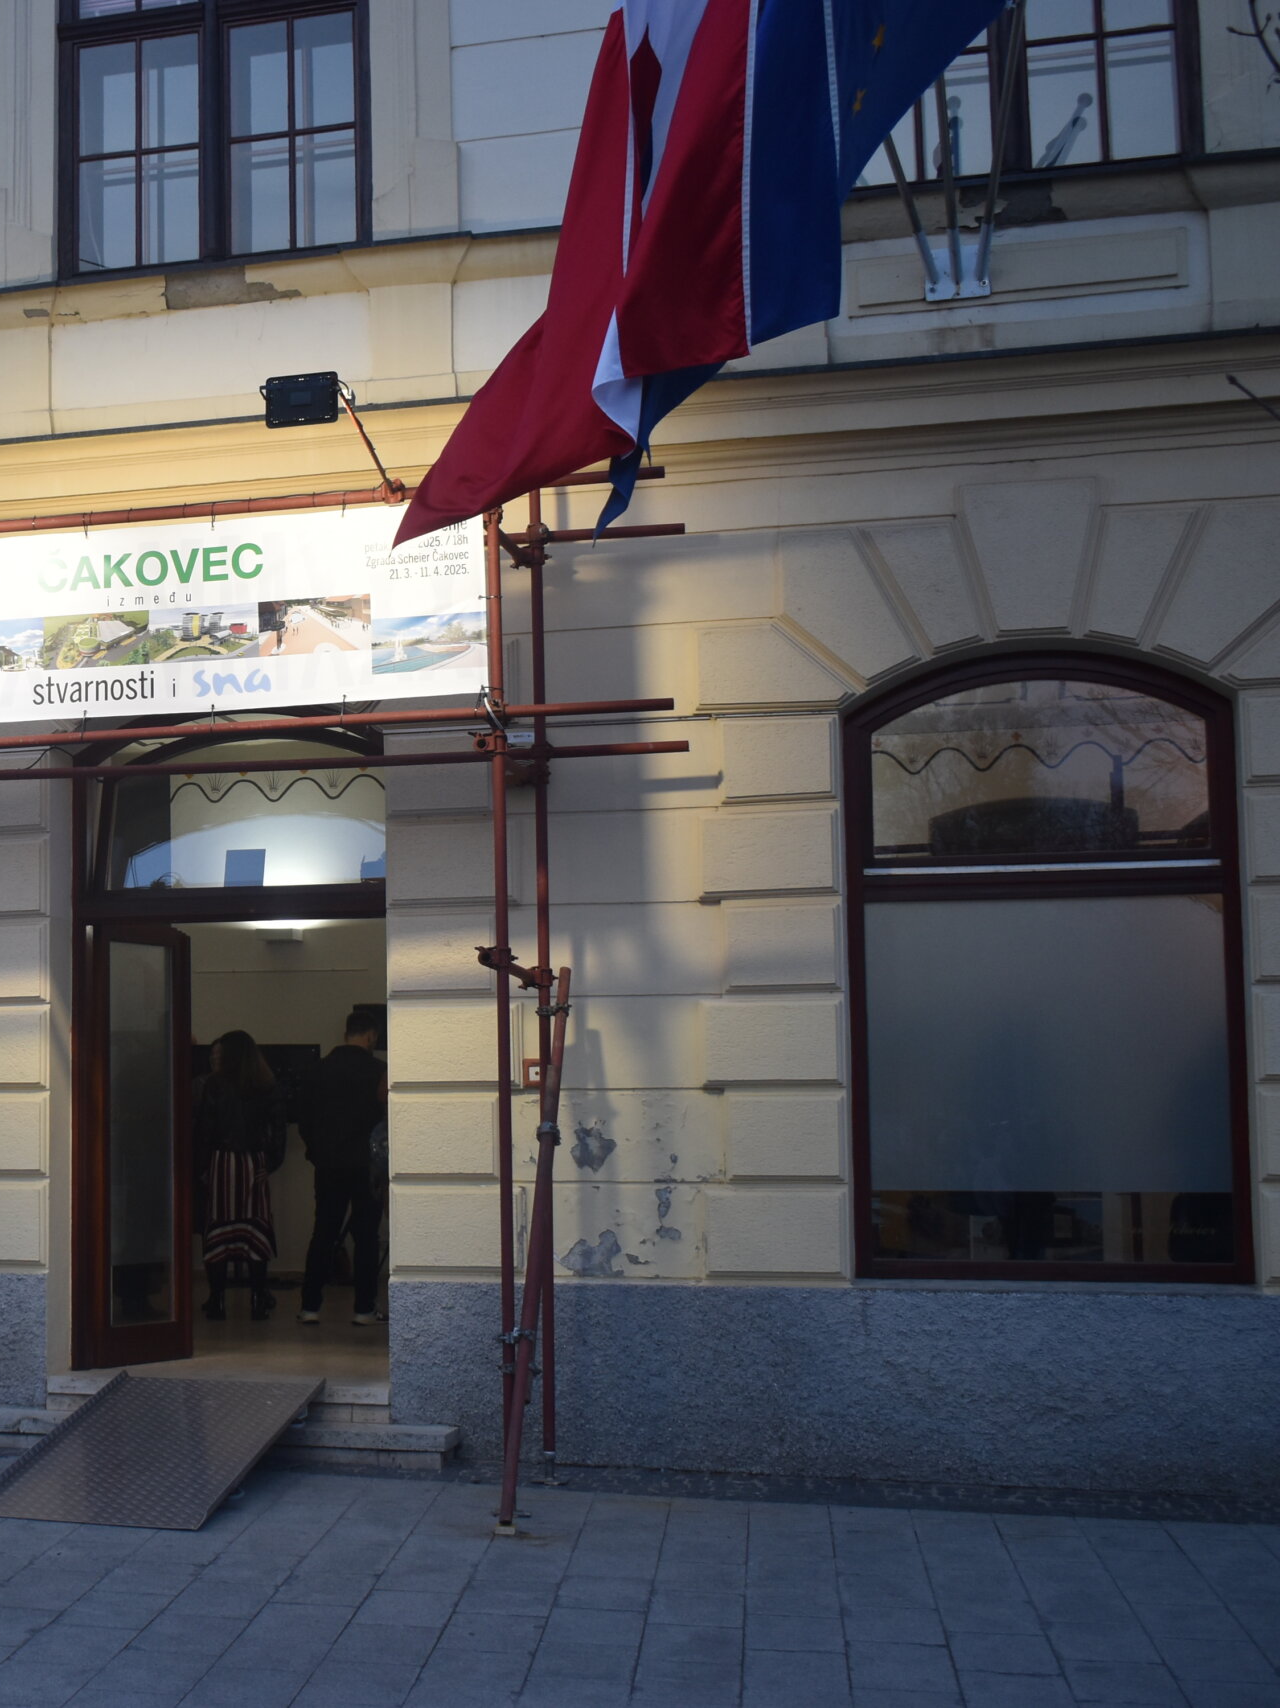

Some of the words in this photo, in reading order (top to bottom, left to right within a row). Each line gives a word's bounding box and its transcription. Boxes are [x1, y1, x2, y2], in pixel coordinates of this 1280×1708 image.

[397, 553, 430, 565] Scheier
[432, 548, 470, 562] Čakovec
[389, 568, 402, 580] 21.
[404, 567, 412, 579] 3.
[433, 565, 442, 577] 4.
[444, 563, 470, 576] 2025.
[32, 670, 155, 705] stvarnosti
[172, 678, 176, 697] i
[192, 668, 272, 697] sna
